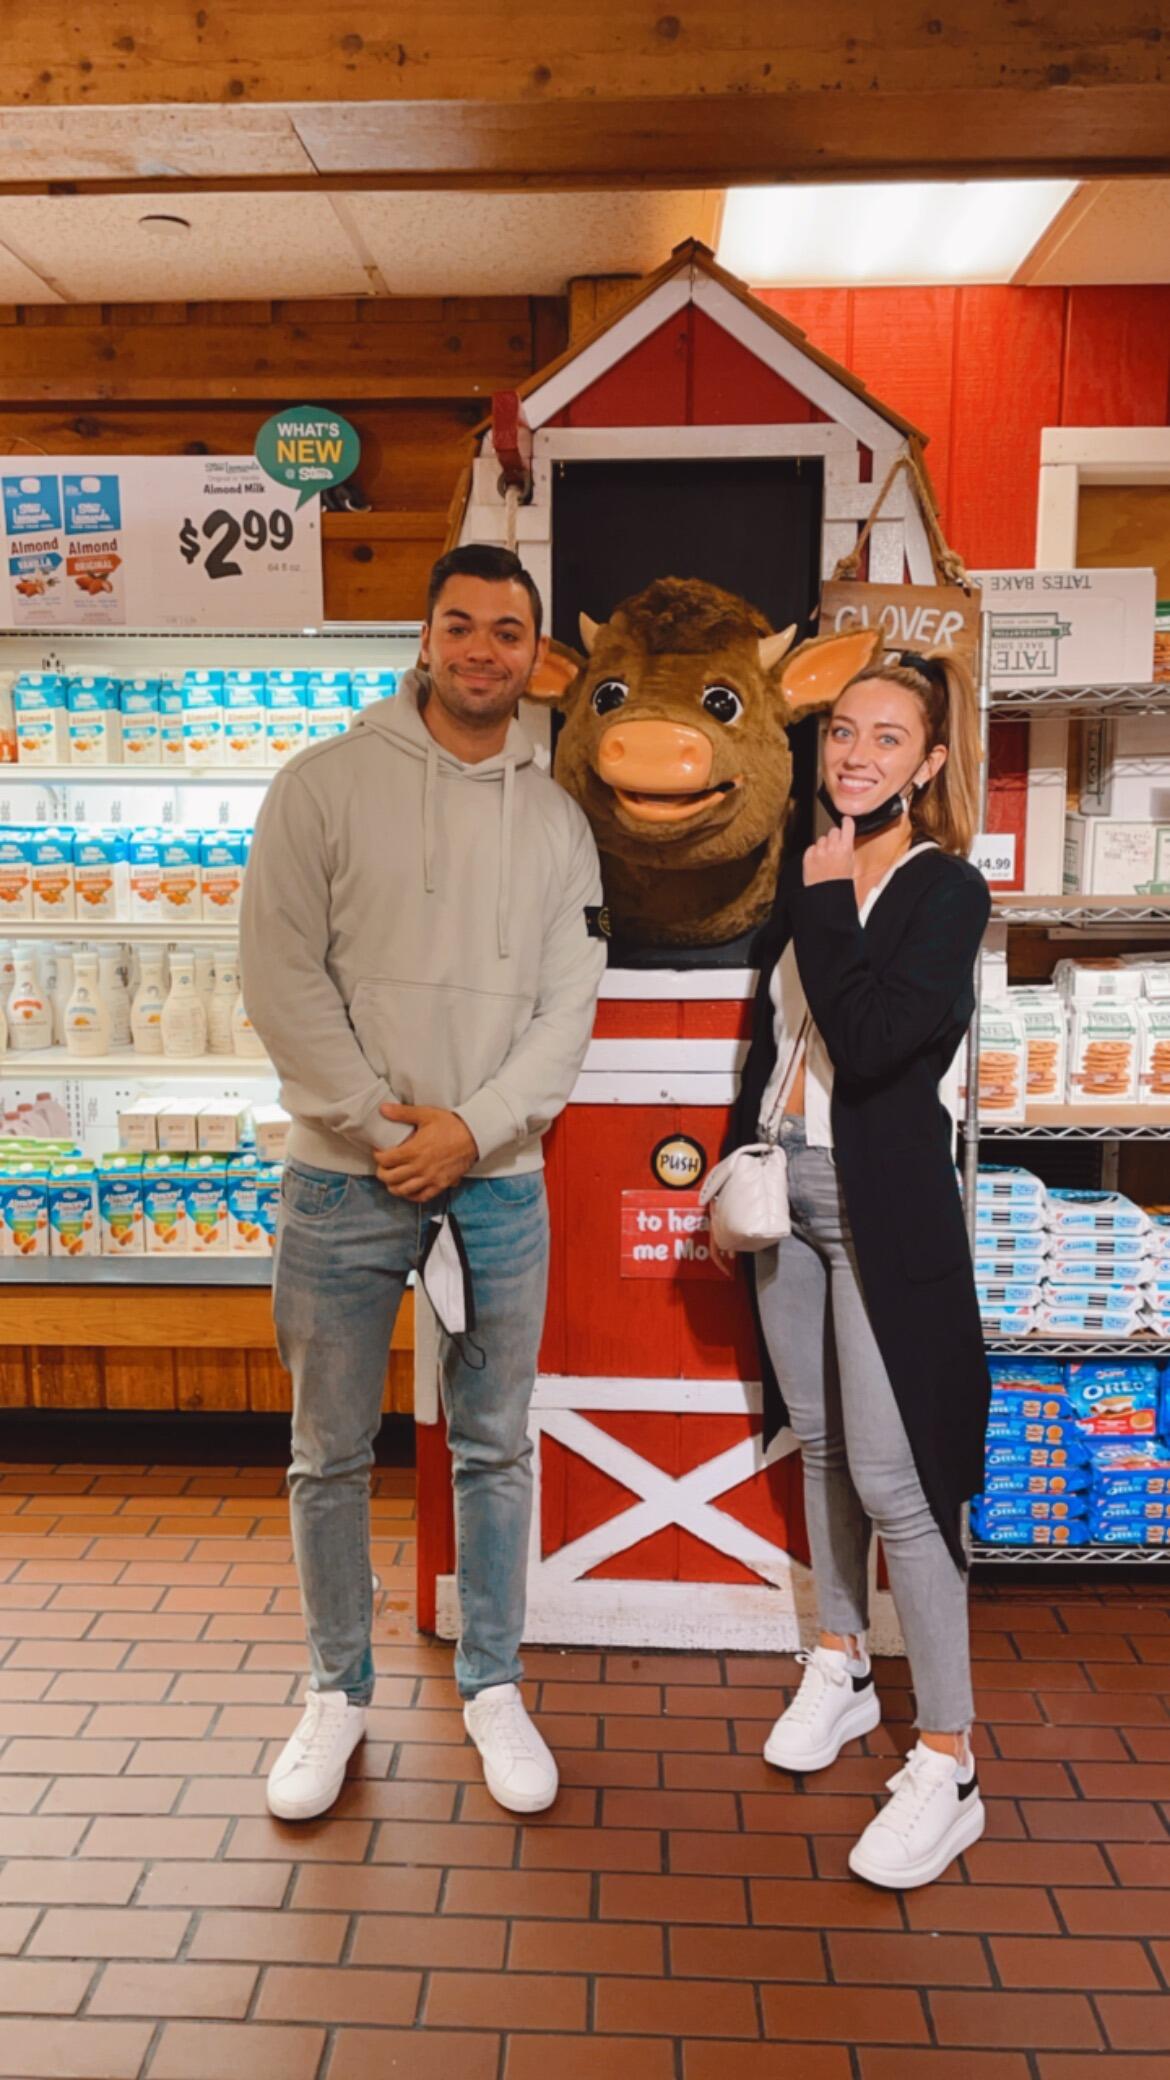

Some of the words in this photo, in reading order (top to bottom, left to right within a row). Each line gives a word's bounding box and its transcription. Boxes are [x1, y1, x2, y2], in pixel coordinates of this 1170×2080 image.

[277, 422, 340, 437] WHAT'S
[277, 439, 343, 464] NEW
[203, 483, 242, 495] Almond
[244, 482, 265, 493] Milk
[11, 537, 59, 555] Almond
[68, 538, 118, 556] Almond
[991, 575, 1035, 591] BAKE
[993, 650, 1051, 671] TATE'
[977, 858, 1011, 871] $4.99
[660, 1154, 699, 1173] PUSH
[636, 1210, 663, 1232] to
[668, 1208, 710, 1232] hea
[632, 1243, 669, 1261] me
[1083, 1381, 1145, 1400] OREO
